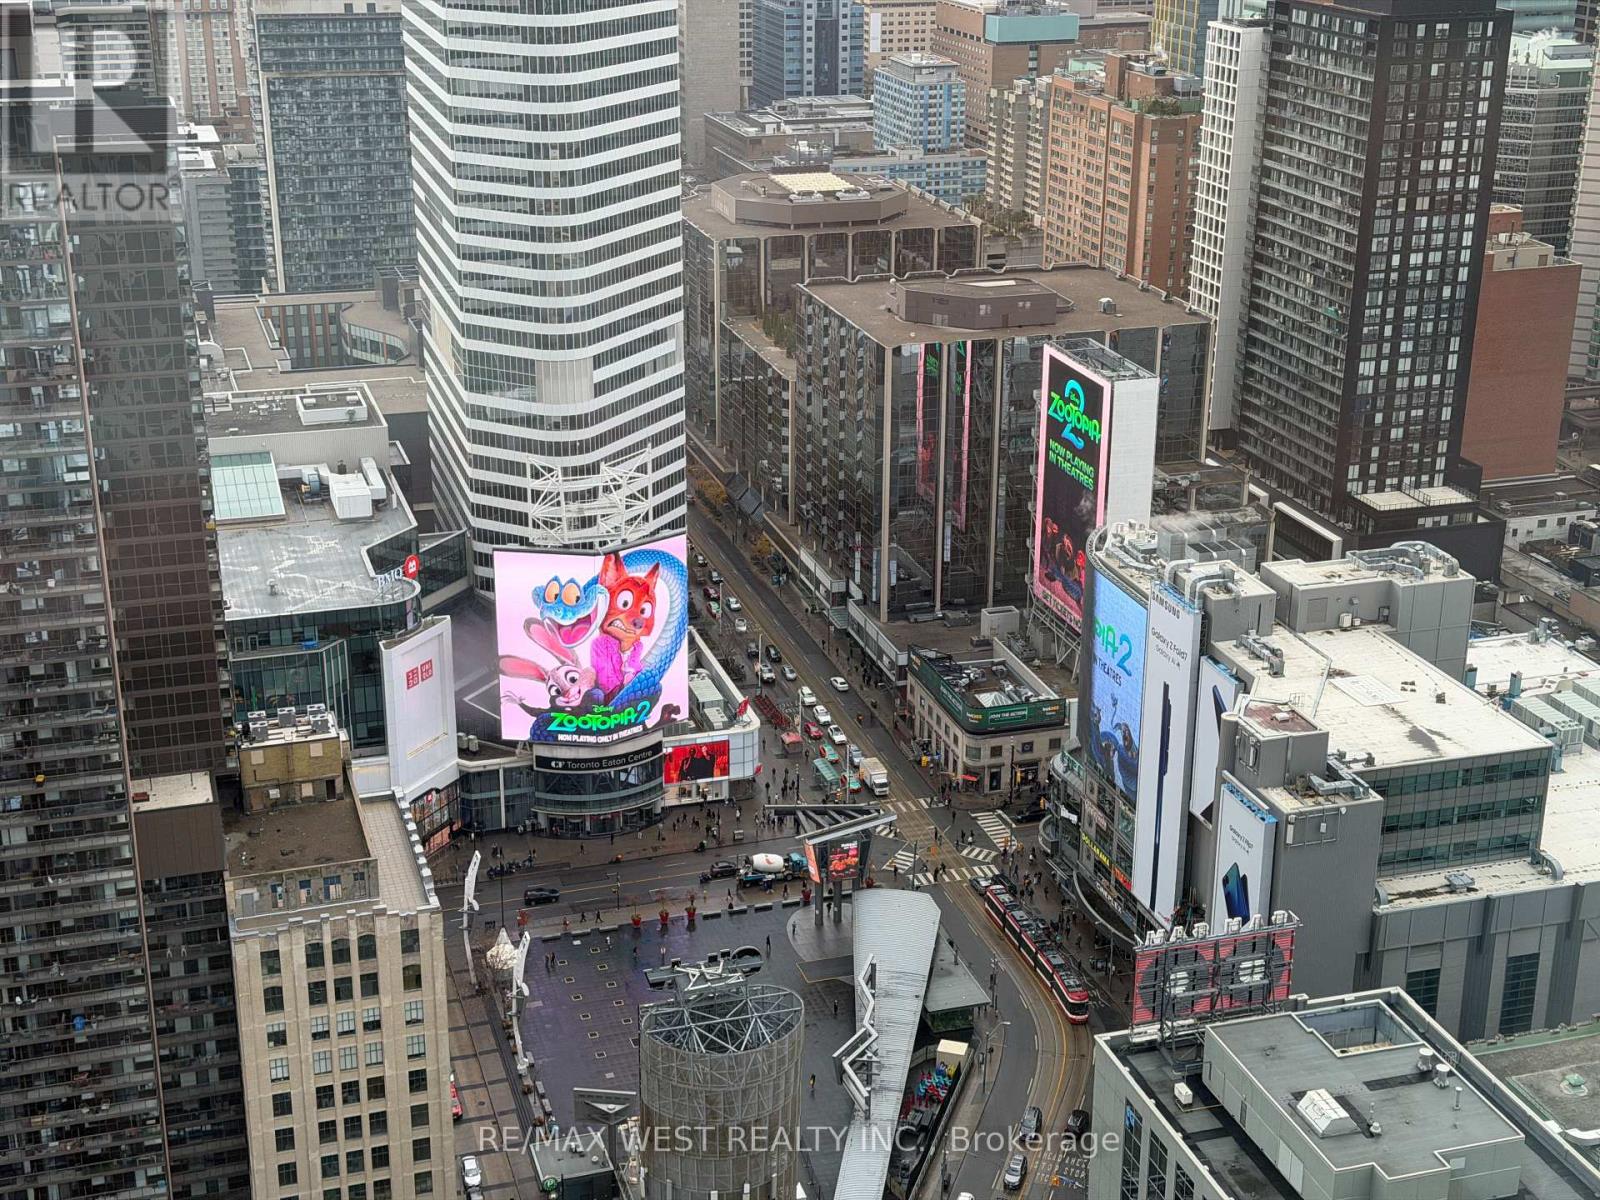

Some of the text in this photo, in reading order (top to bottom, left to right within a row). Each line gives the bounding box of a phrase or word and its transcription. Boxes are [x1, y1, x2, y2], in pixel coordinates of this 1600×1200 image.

[1049, 438, 1095, 479] NOW PLAYING
[1049, 450, 1094, 491] IN THEATRES
[377, 568, 404, 588] BMO
[1151, 590, 1181, 620] SAMSUNG
[1151, 626, 1170, 649] Galaxy
[636, 700, 651, 725] 2
[558, 734, 572, 742] NOW
[572, 735, 597, 743] PLAYING
[597, 735, 614, 743] ONLY
[567, 761, 600, 770] Toronto
[602, 756, 626, 768] Eaton
[628, 750, 653, 763] Centre
[1081, 832, 1110, 867] DOLLARAMA
[1095, 881, 1123, 915] CINEPLEX
